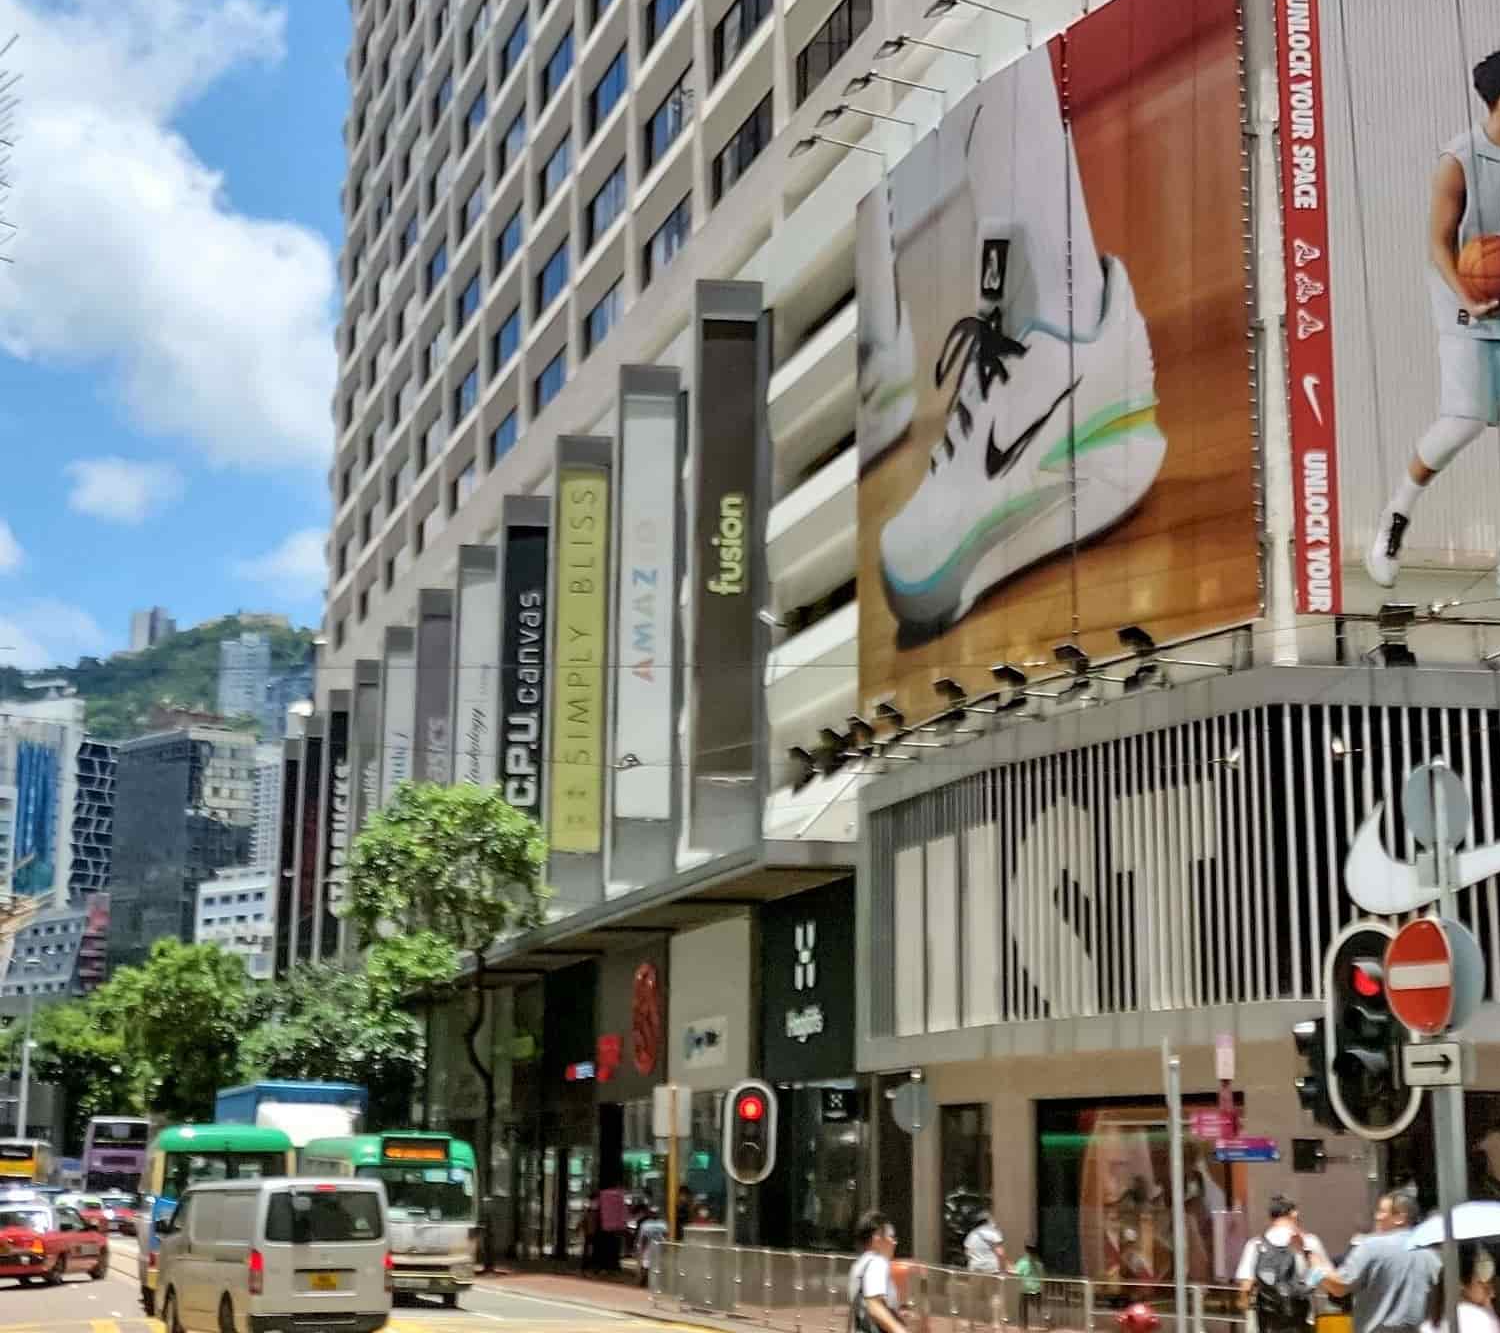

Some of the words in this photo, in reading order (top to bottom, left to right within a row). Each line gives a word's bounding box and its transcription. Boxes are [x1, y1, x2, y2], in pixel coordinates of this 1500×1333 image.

[1289, 80, 1315, 141] YOUR
[1292, 144, 1318, 209] SPACE
[568, 488, 598, 595] BLISS
[707, 495, 744, 595] fusion
[1303, 452, 1331, 544] UNLOCK
[1306, 547, 1333, 613] YOUR
[516, 590, 545, 705] canvas
[565, 625, 593, 765] SIMPLY
